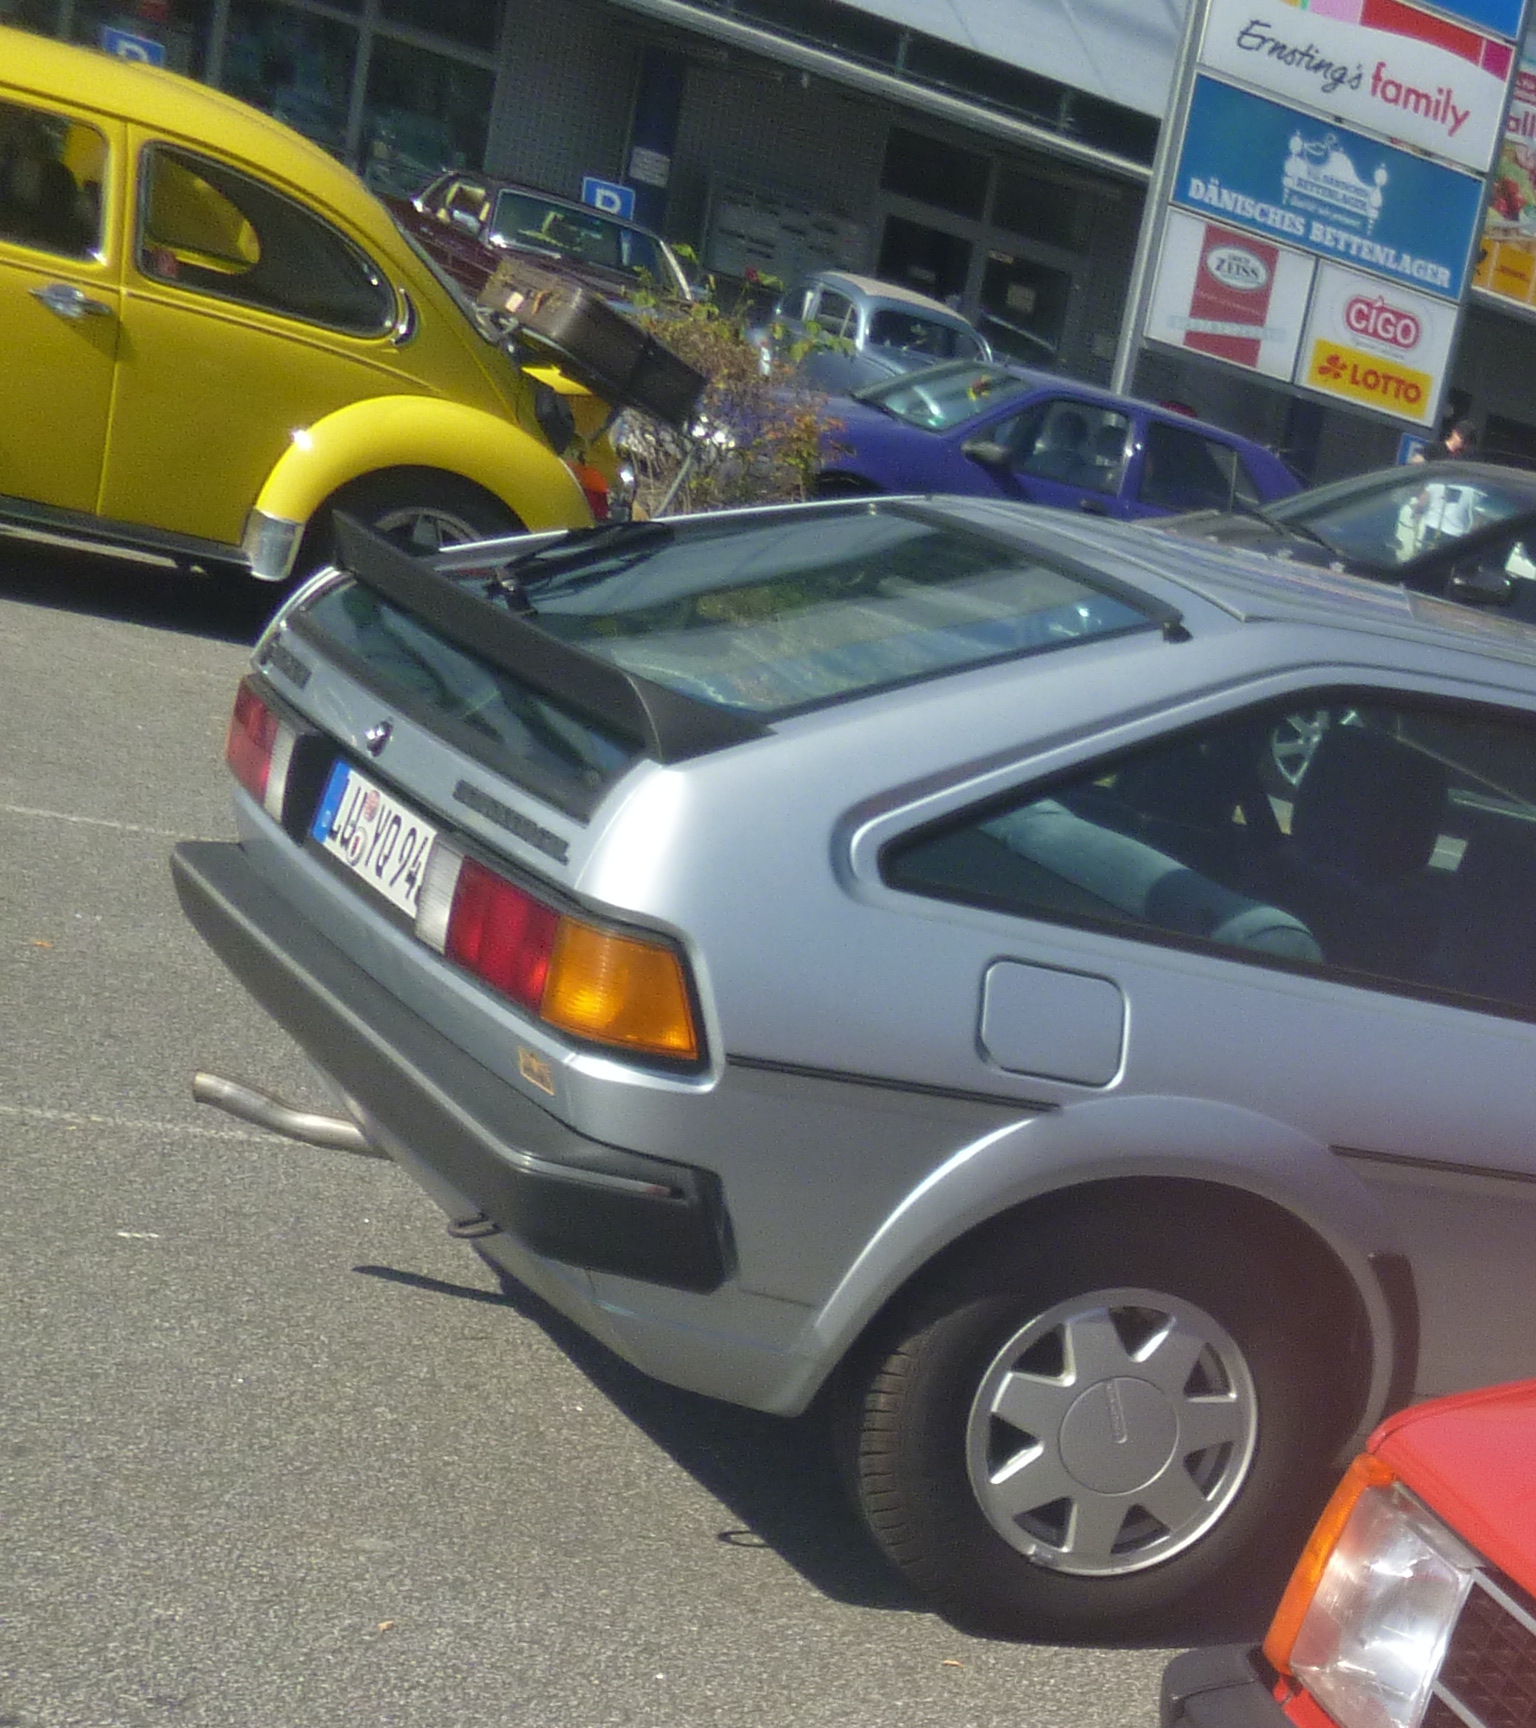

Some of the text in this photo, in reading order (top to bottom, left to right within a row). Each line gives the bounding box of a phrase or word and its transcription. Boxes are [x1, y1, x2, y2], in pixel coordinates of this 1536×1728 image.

[1236, 19, 1364, 94] Ernsting's
[1370, 60, 1471, 137] family
[1187, 175, 1306, 237] DÄNISCHES
[1308, 220, 1452, 289] BETTENLAGER
[1214, 256, 1260, 281] ZEISS
[1350, 301, 1418, 346] CIGO
[1350, 363, 1423, 405] LOTTO
